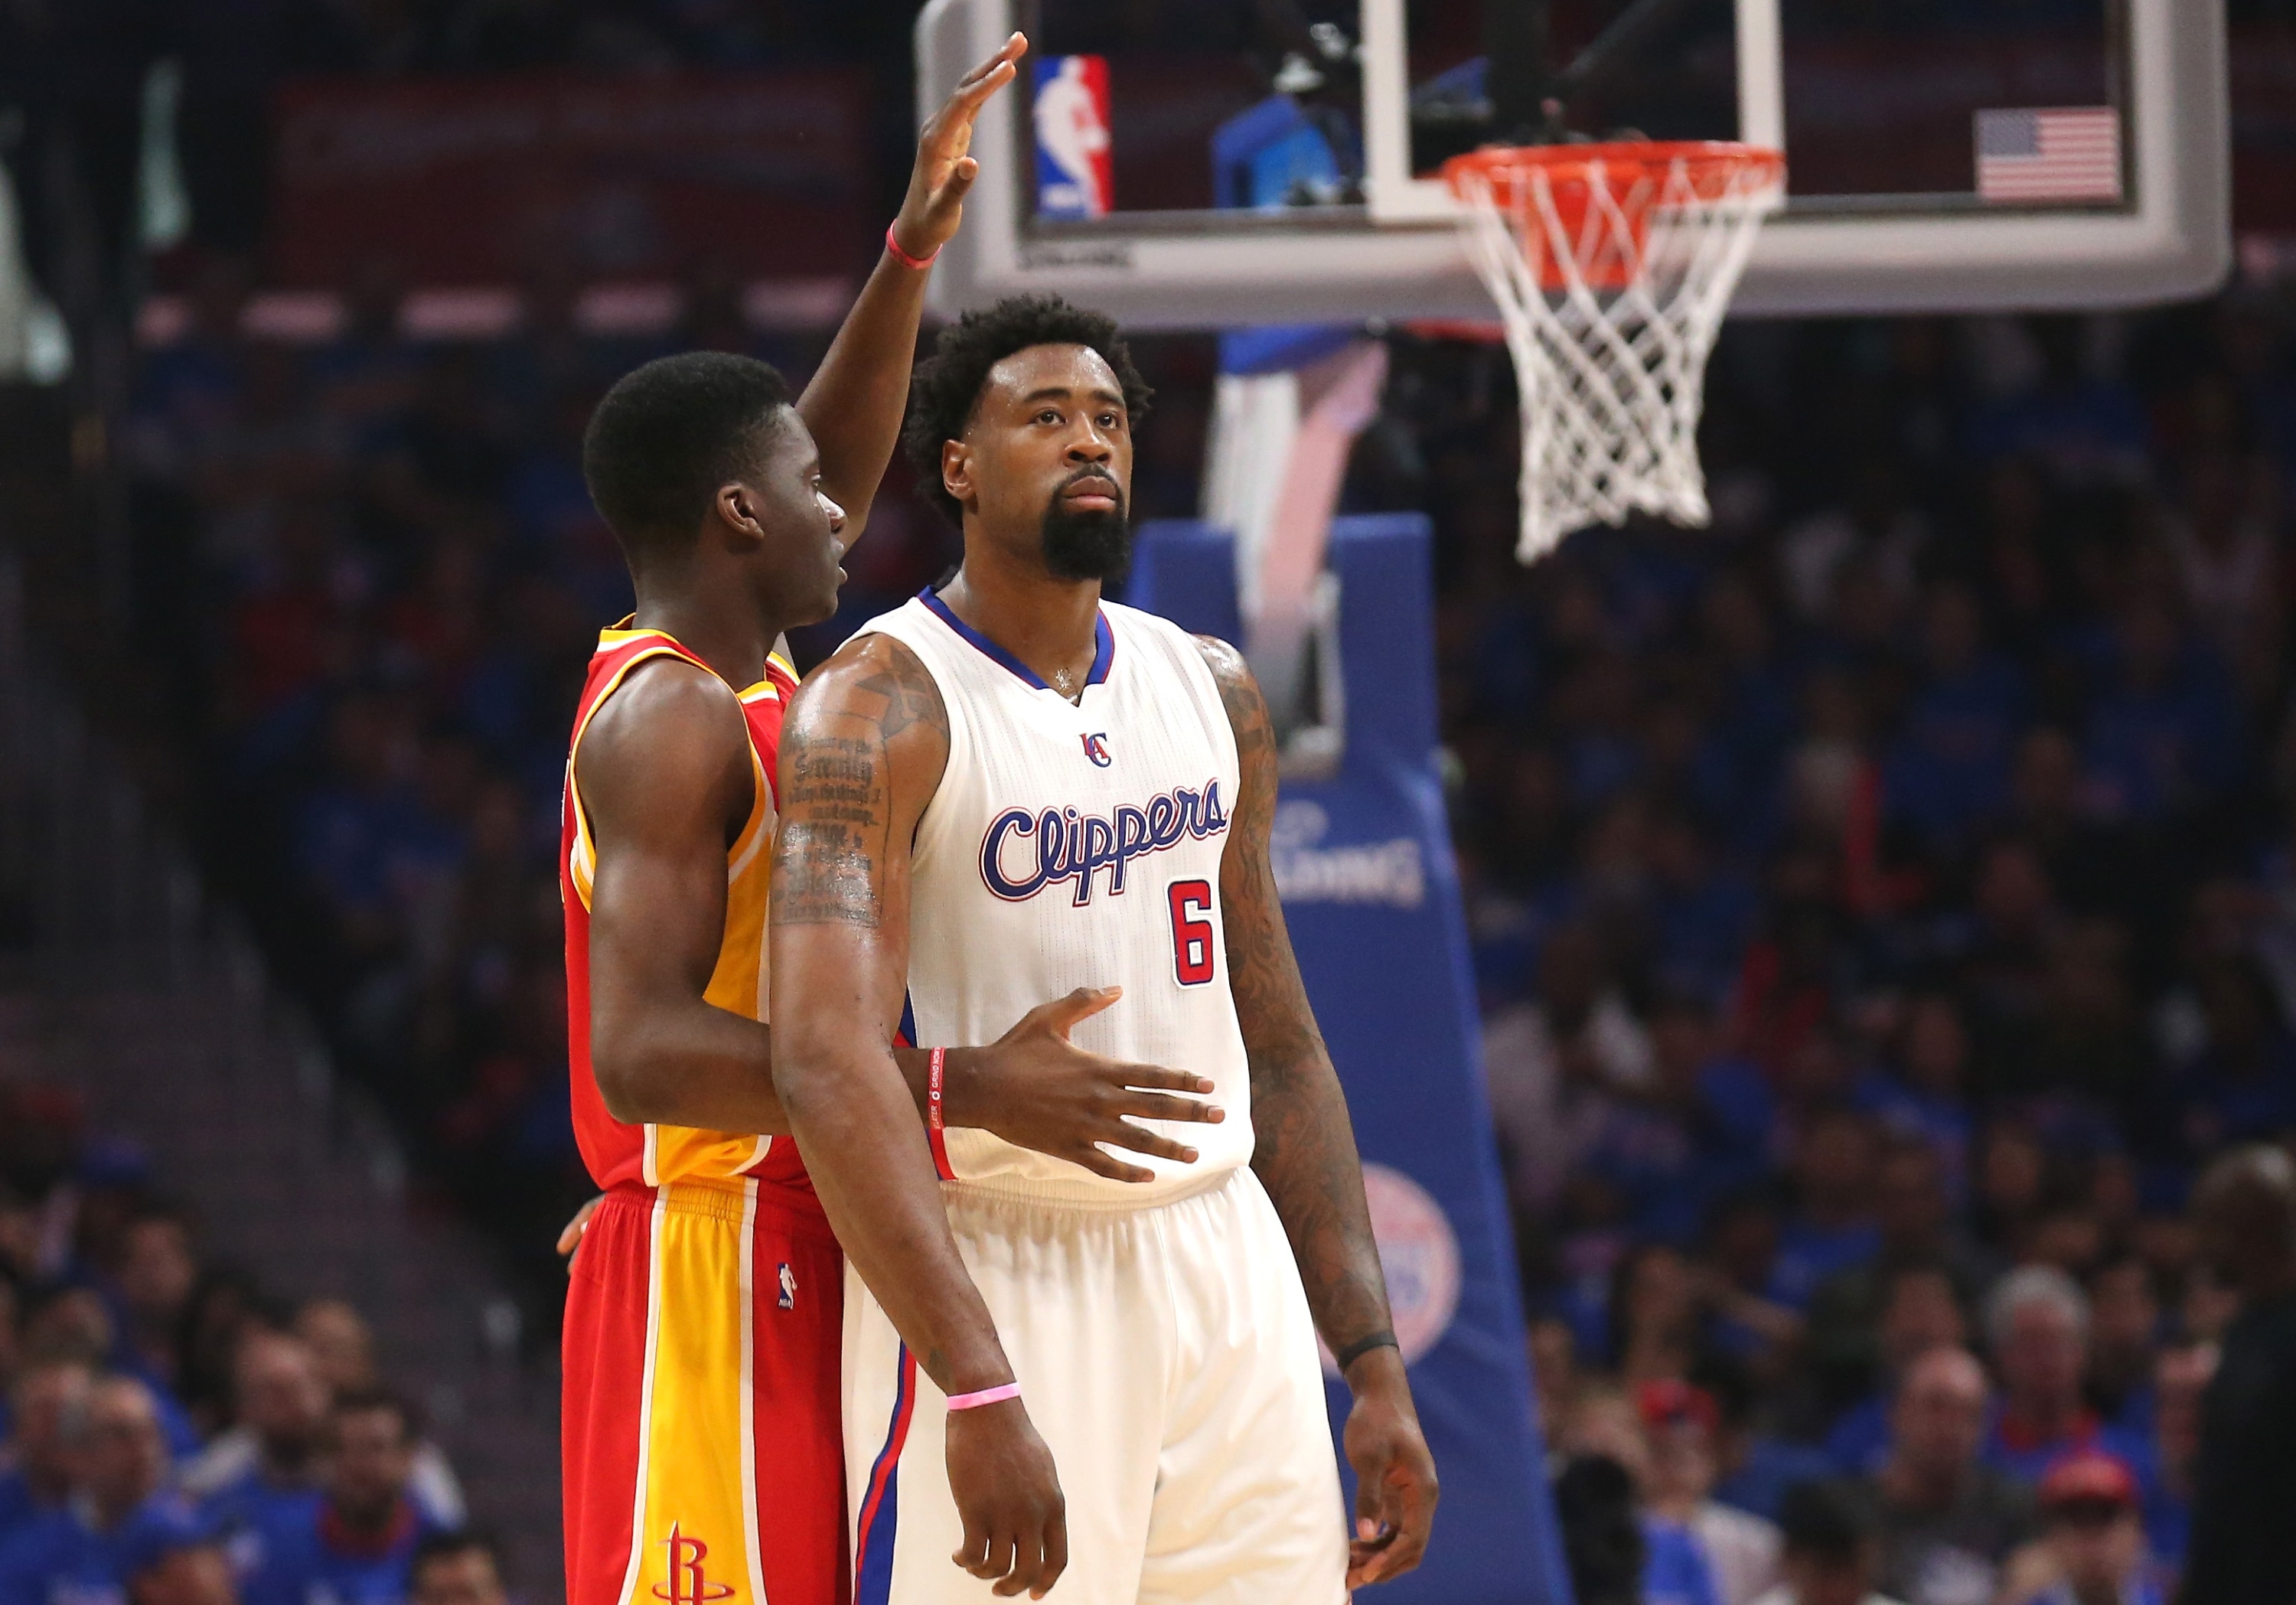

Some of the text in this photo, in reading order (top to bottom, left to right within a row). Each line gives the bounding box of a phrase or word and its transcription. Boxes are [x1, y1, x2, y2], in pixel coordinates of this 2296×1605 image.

[978, 778, 1229, 908] Clippers
[1168, 879, 1215, 986] 6
[931, 1065, 940, 1088] GRIND
